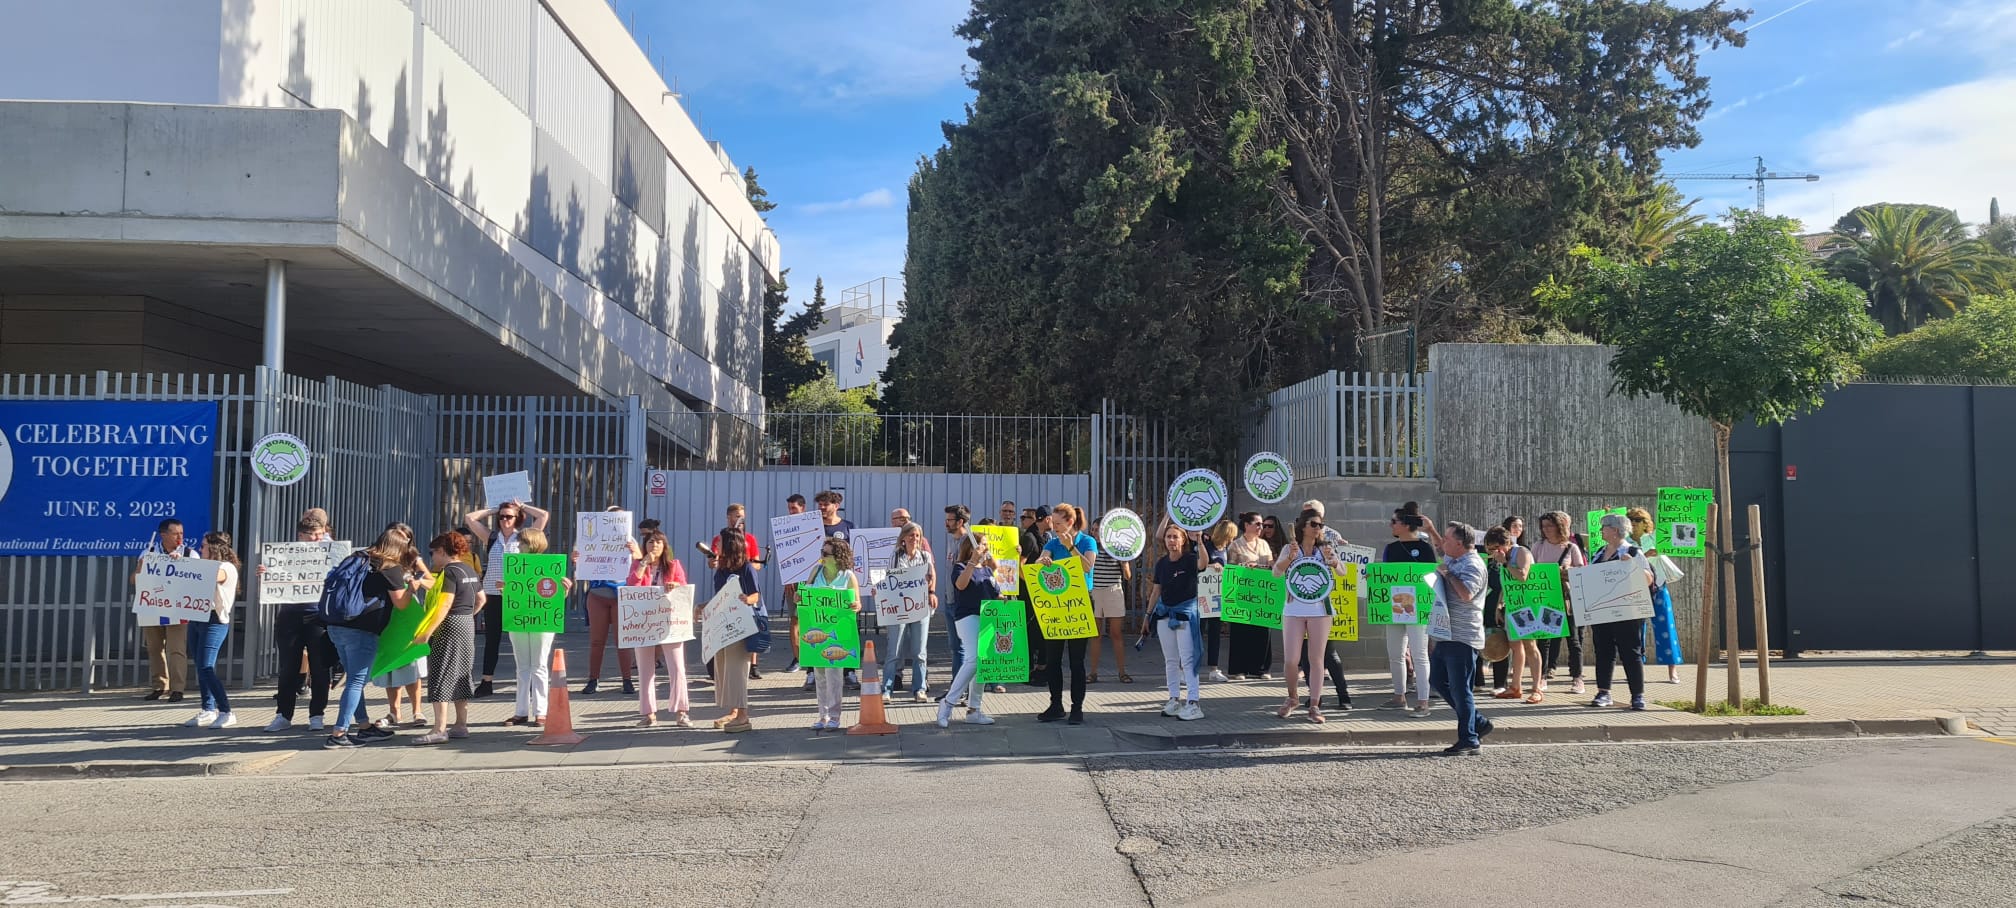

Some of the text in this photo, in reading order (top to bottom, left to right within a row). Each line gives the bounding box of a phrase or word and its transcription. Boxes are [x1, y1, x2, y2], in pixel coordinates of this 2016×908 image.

[15, 423, 209, 445] CELEBRATING
[266, 440, 297, 449] BOARD
[32, 455, 189, 477] TOGETHER
[1253, 459, 1279, 468] BOARD
[264, 473, 295, 482] STAFF
[1180, 476, 1212, 487] BOARD
[1259, 491, 1282, 499] STAFF
[1659, 490, 1708, 501] More work
[44, 501, 176, 519] JUNE 8, 2023
[1683, 502, 1696, 512] of
[1181, 516, 1212, 526] STAFF
[1658, 513, 1693, 523] benefits
[783, 525, 800, 534] SALARY
[0, 538, 49, 550] national
[52, 537, 115, 550] Education
[124, 538, 153, 550] sinc
[601, 544, 625, 552] TRUTH
[785, 537, 800, 547] RENT
[265, 543, 331, 555] Professional
[268, 556, 332, 568] Development
[507, 556, 545, 576] Put a
[781, 561, 792, 570] ASB
[146, 562, 202, 580] We Deserve
[264, 572, 321, 582] DOES NOT
[1373, 566, 1424, 583] How doe
[1539, 571, 1547, 579] a
[1197, 574, 1222, 593] ransp
[1225, 567, 1278, 591] There are
[1341, 579, 1356, 591] the
[267, 587, 285, 597] my
[1505, 580, 1554, 597] proposal
[140, 590, 172, 607] Raise
[183, 595, 211, 613] 2023
[507, 594, 552, 609] to the
[798, 588, 851, 609] It smells
[1237, 590, 1261, 603] sides
[1264, 592, 1275, 605] to
[1368, 587, 1390, 604] ASB
[1417, 593, 1433, 604] cut
[1509, 592, 1548, 605] full of
[622, 604, 675, 624] Do you know
[880, 599, 899, 616] Fair
[514, 610, 547, 630] spin!
[815, 609, 838, 623] like
[1041, 613, 1087, 624] Give us a
[1226, 607, 1282, 625] every story
[1371, 607, 1389, 622] the
[623, 621, 645, 631] where
[646, 620, 664, 633] your
[1333, 617, 1354, 627] ldn't
[1328, 626, 1355, 639] ere!!
[623, 635, 645, 645] money
[996, 673, 1025, 681] deserve
